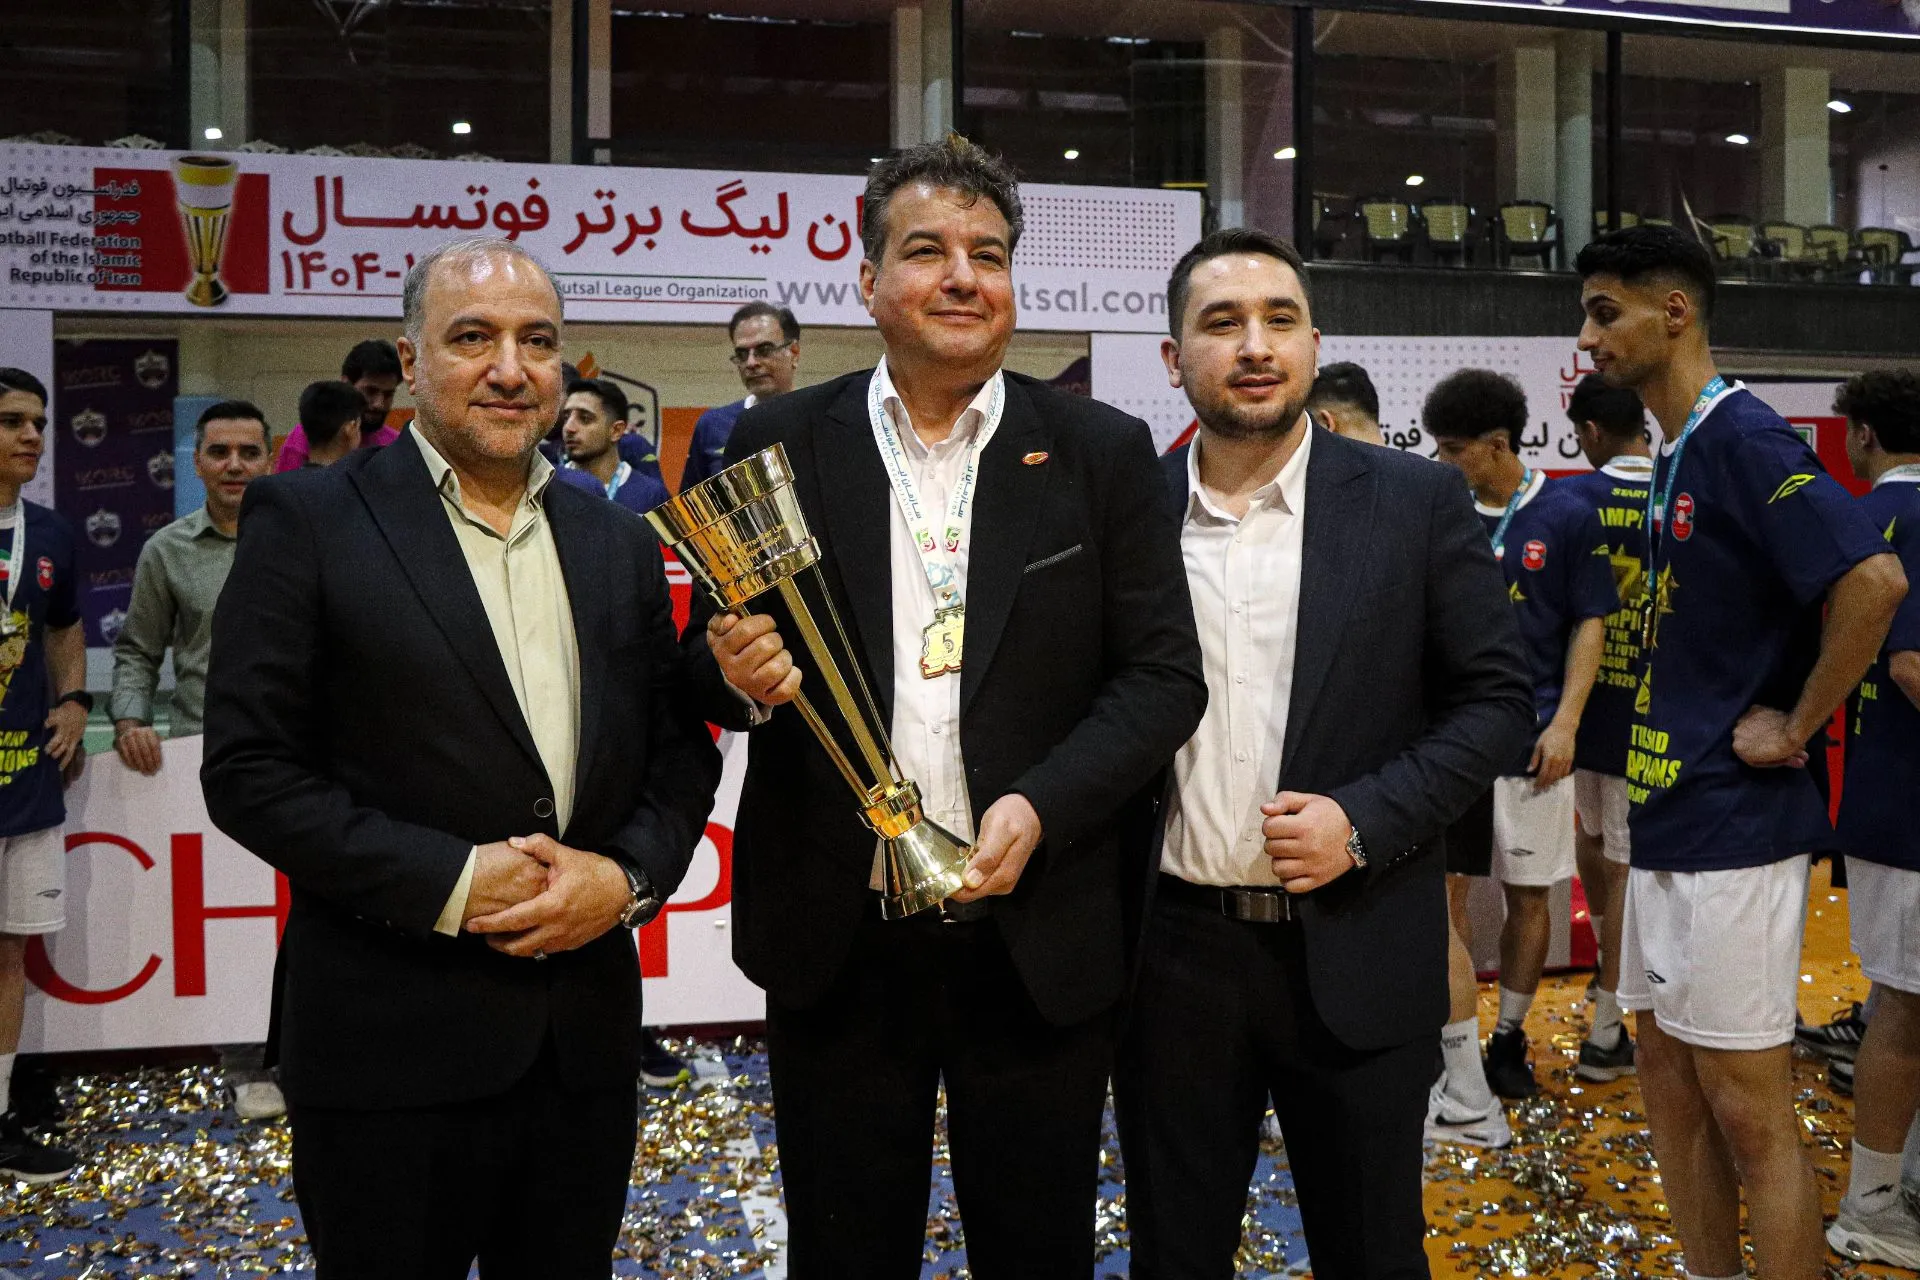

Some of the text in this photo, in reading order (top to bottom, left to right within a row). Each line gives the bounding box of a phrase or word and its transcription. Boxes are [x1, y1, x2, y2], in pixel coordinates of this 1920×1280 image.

[562, 188, 662, 256] برتر
[680, 179, 790, 255] لیگ
[0, 231, 141, 249] otball Federation
[30, 250, 141, 267] of the Islamic
[10, 268, 83, 286] Republic
[562, 279, 769, 300] utsal League Organization
